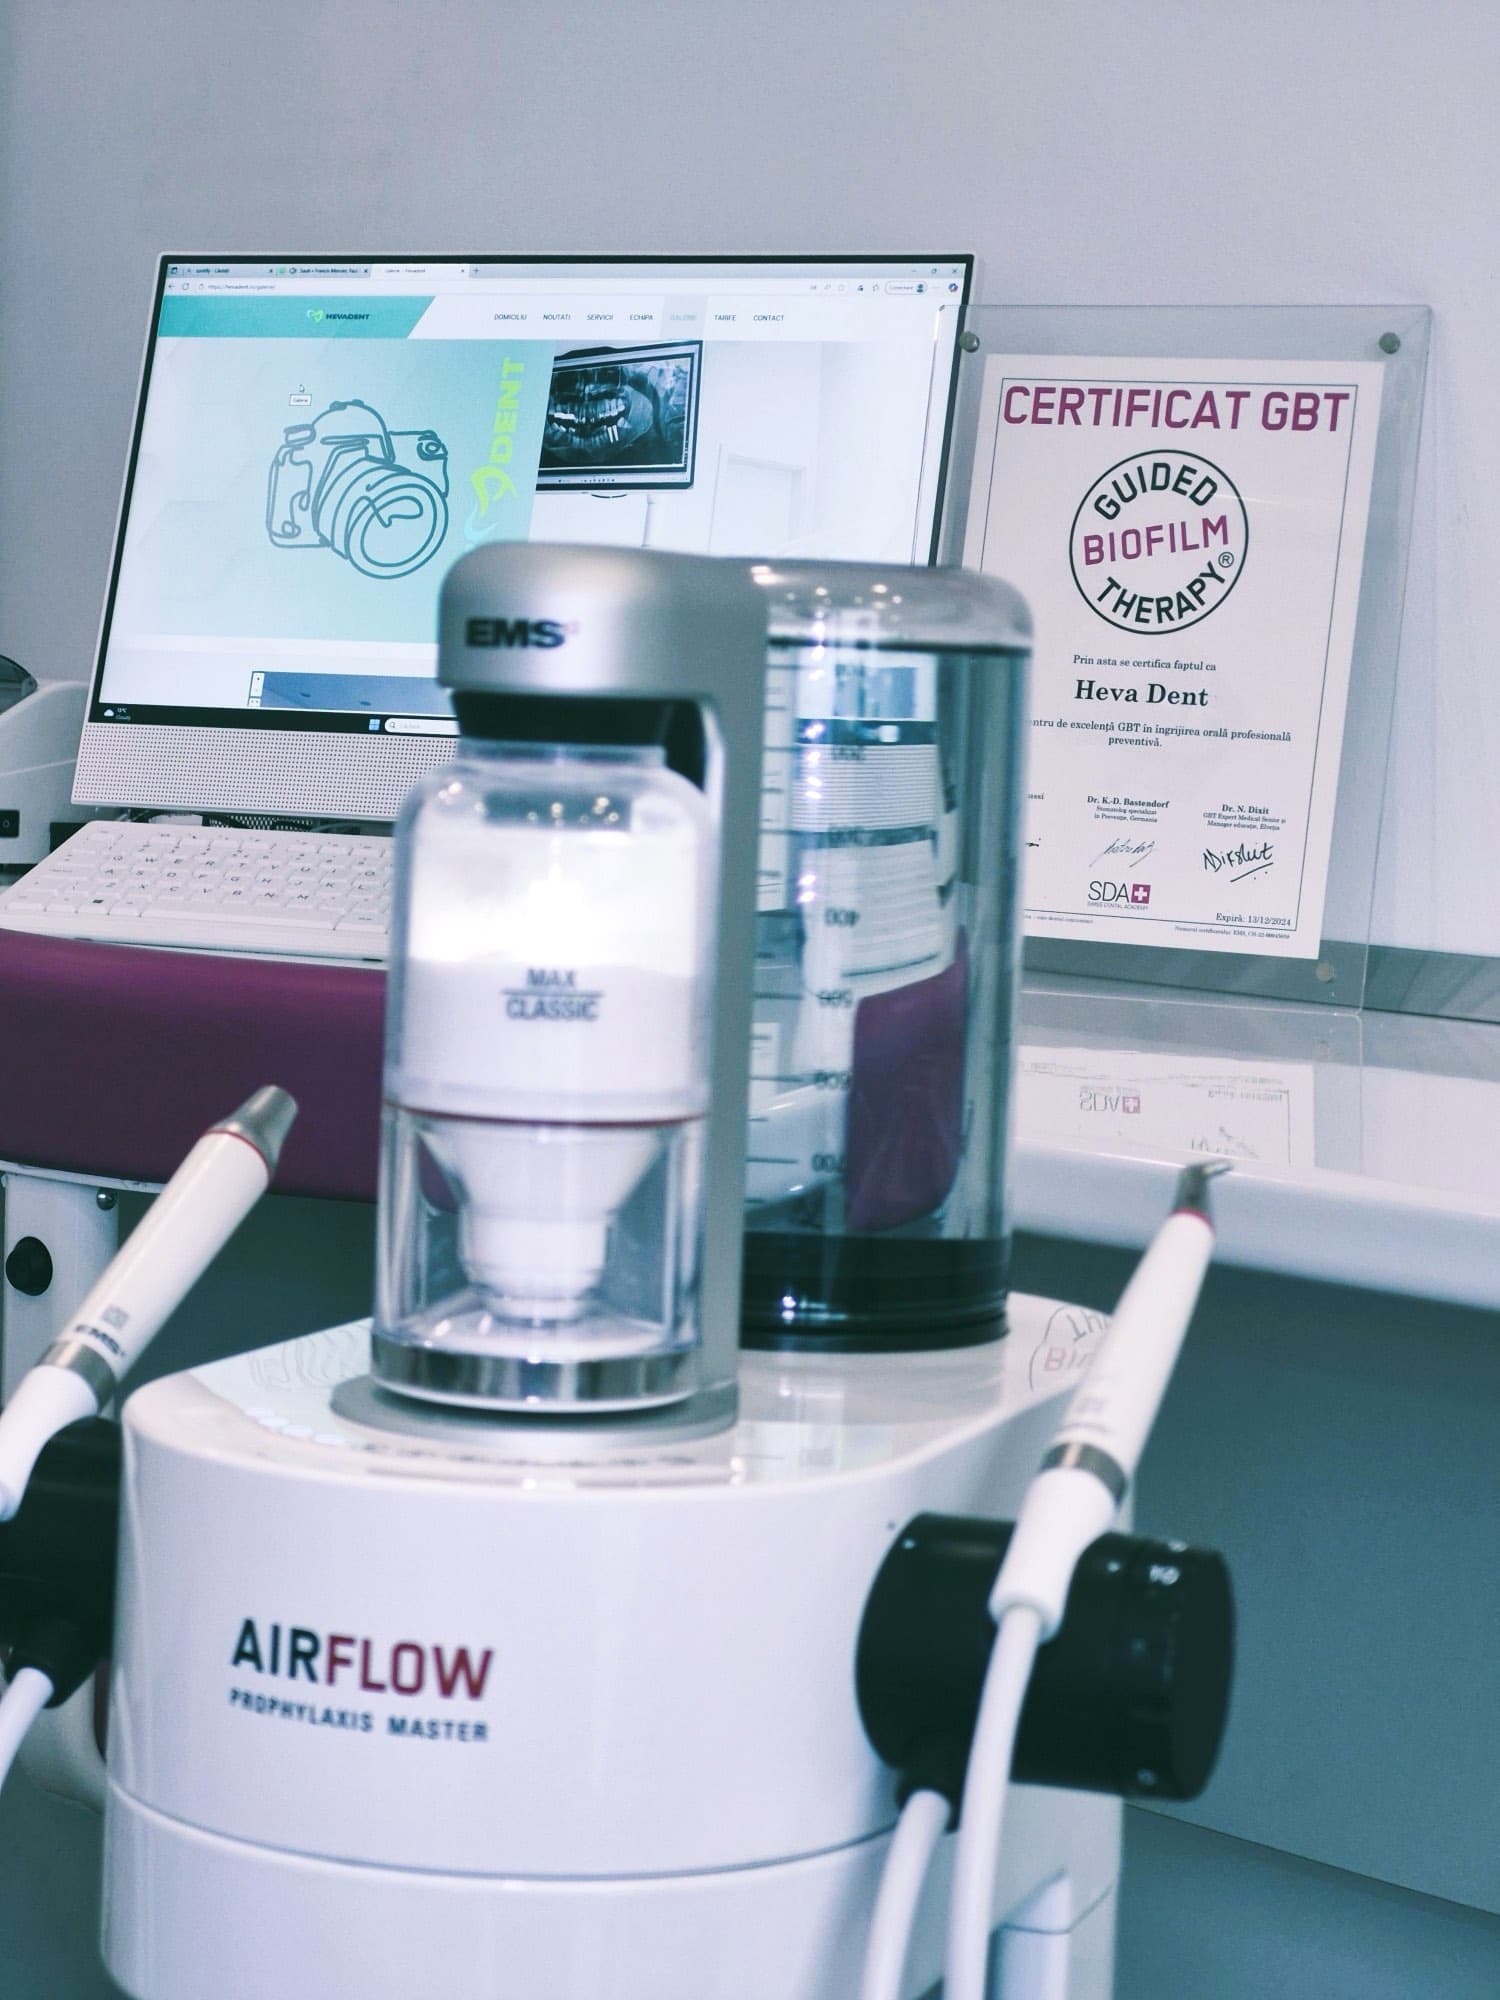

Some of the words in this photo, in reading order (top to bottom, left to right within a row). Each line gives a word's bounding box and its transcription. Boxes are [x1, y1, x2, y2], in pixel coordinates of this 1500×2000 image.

[494, 313, 527, 321] DOMICILIU
[586, 313, 614, 321] SERVICII
[489, 356, 525, 464] DENT
[1003, 385, 1251, 430] CERTIFICAT
[1261, 391, 1351, 432] GBT
[1094, 462, 1218, 520] GUIDED
[1083, 514, 1229, 566] BIOFILM
[465, 617, 567, 649] EMS
[1073, 654, 1094, 665] Prin
[1096, 657, 1117, 667] asta
[1120, 659, 1130, 667] se
[1132, 657, 1171, 669] certifica
[1173, 659, 1203, 672] faptul
[1205, 663, 1216, 671] ca
[1074, 679, 1138, 703] Heva
[1145, 683, 1209, 707] Dent
[1030, 718, 1054, 728] ntru
[1056, 718, 1069, 728] de
[1070, 721, 1115, 732] excelență
[1118, 722, 1140, 732] GBT
[1203, 727, 1228, 738] orală
[1230, 729, 1292, 742] profesională
[1108, 735, 1162, 747] preventivă.
[1087, 795, 1100, 804] Dr.
[1123, 797, 1170, 808] Bastendorf
[1222, 803, 1235, 812] Dr.
[1237, 804, 1246, 813] N.
[1248, 805, 1269, 815] Dixit
[1088, 880, 1130, 902] SDA
[1248, 915, 1291, 926] 13/12/2024
[526, 967, 576, 987] MAX
[506, 997, 600, 1022] CLASSIC
[231, 1617, 494, 1701] AIRFLOW
[229, 1687, 374, 1733] PROPHYLAXIS
[387, 1715, 488, 1742] MASTER
